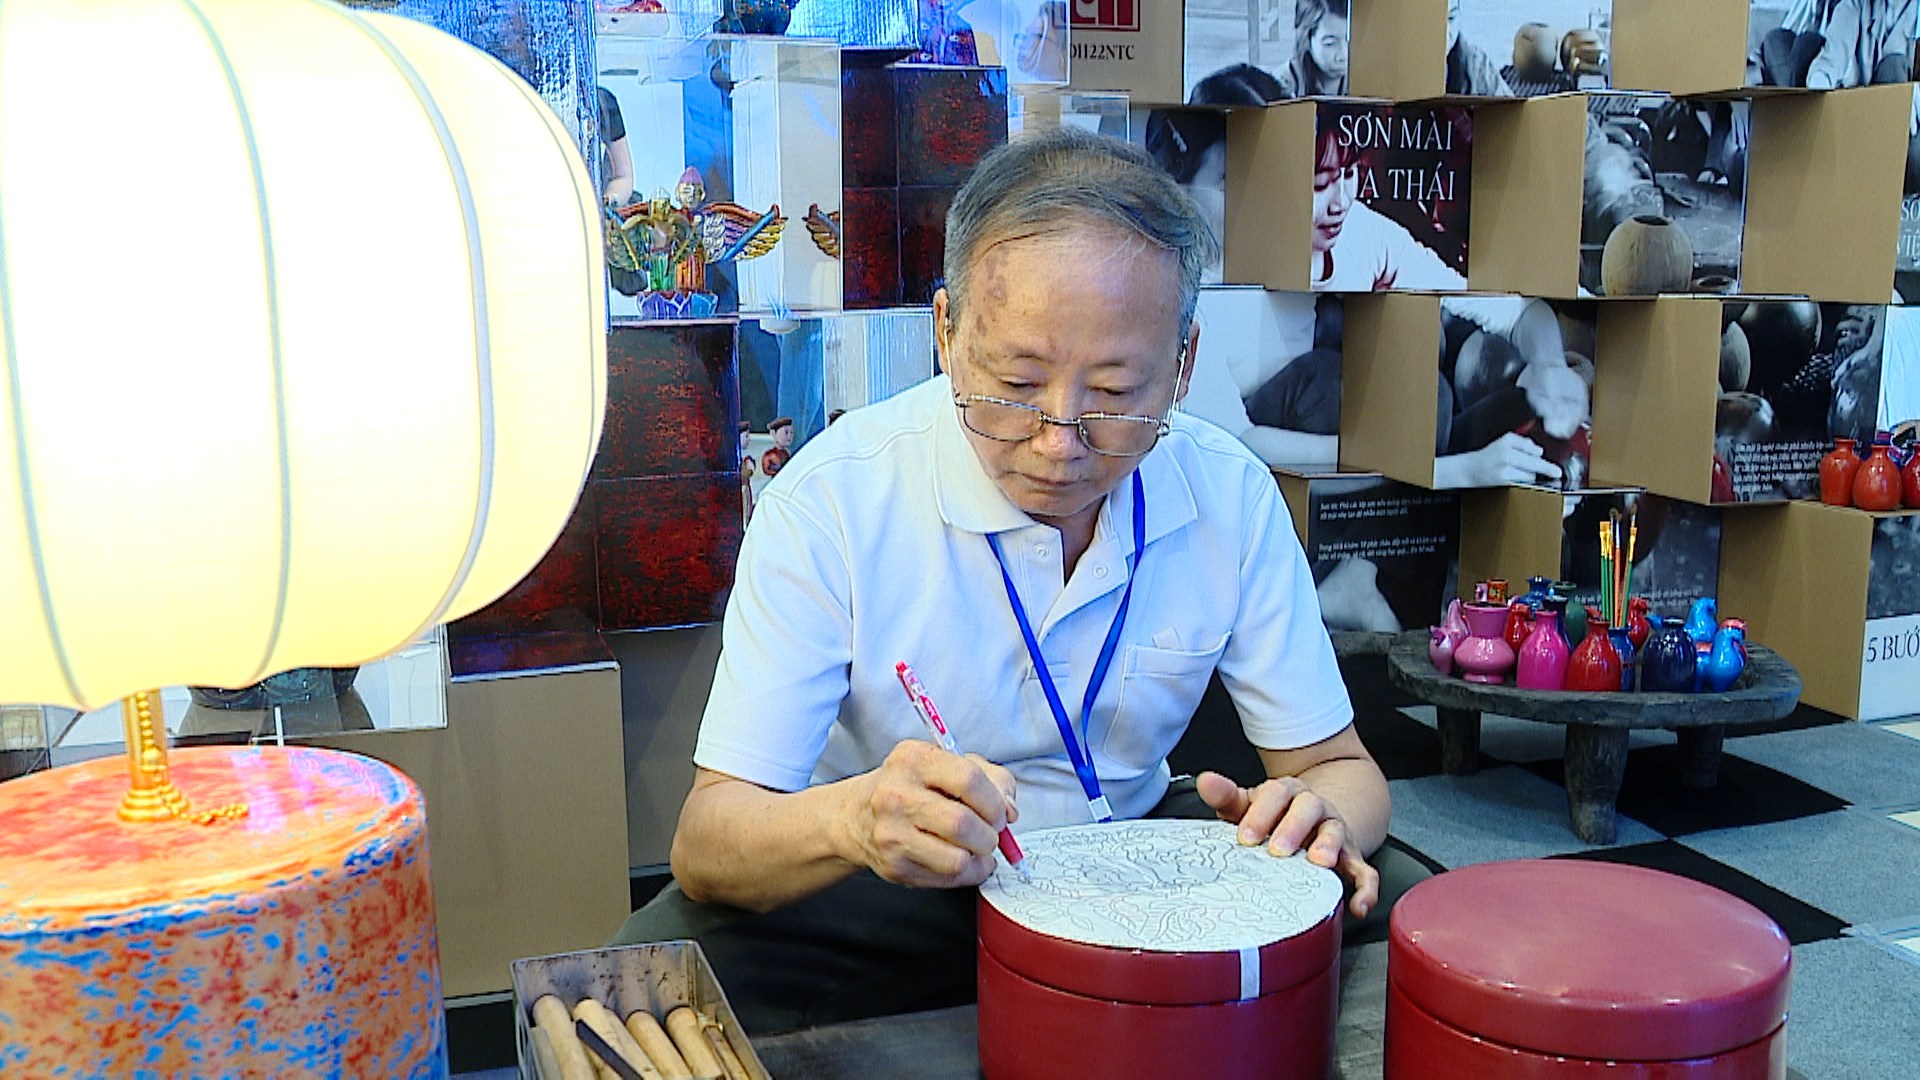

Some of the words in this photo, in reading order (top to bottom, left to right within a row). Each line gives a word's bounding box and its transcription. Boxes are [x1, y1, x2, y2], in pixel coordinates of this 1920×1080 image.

[1338, 110, 1392, 149] SƠN
[1399, 110, 1453, 150] MÀI
[1387, 160, 1456, 201] THÁI
[1866, 636, 1878, 662] 5
